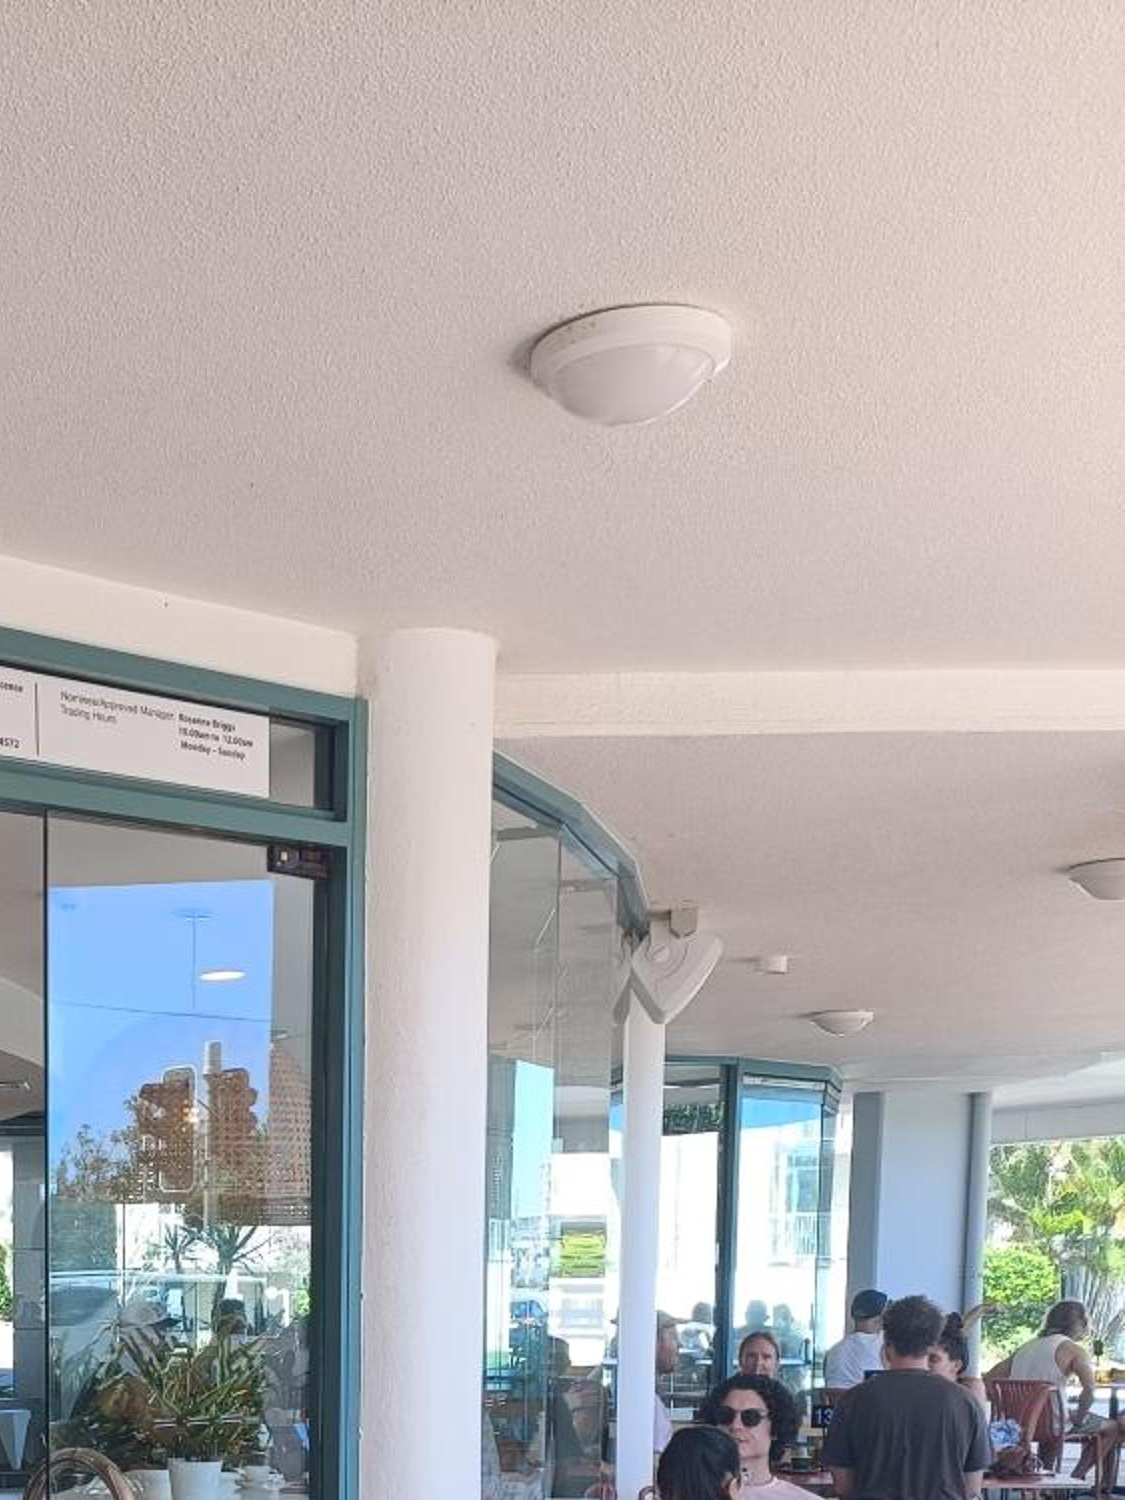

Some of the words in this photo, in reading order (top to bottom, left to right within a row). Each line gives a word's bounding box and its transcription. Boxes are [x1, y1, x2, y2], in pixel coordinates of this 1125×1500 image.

[60, 705, 90, 722] Trading
[0, 735, 20, 749] 4572
[180, 739, 211, 757] Monday
